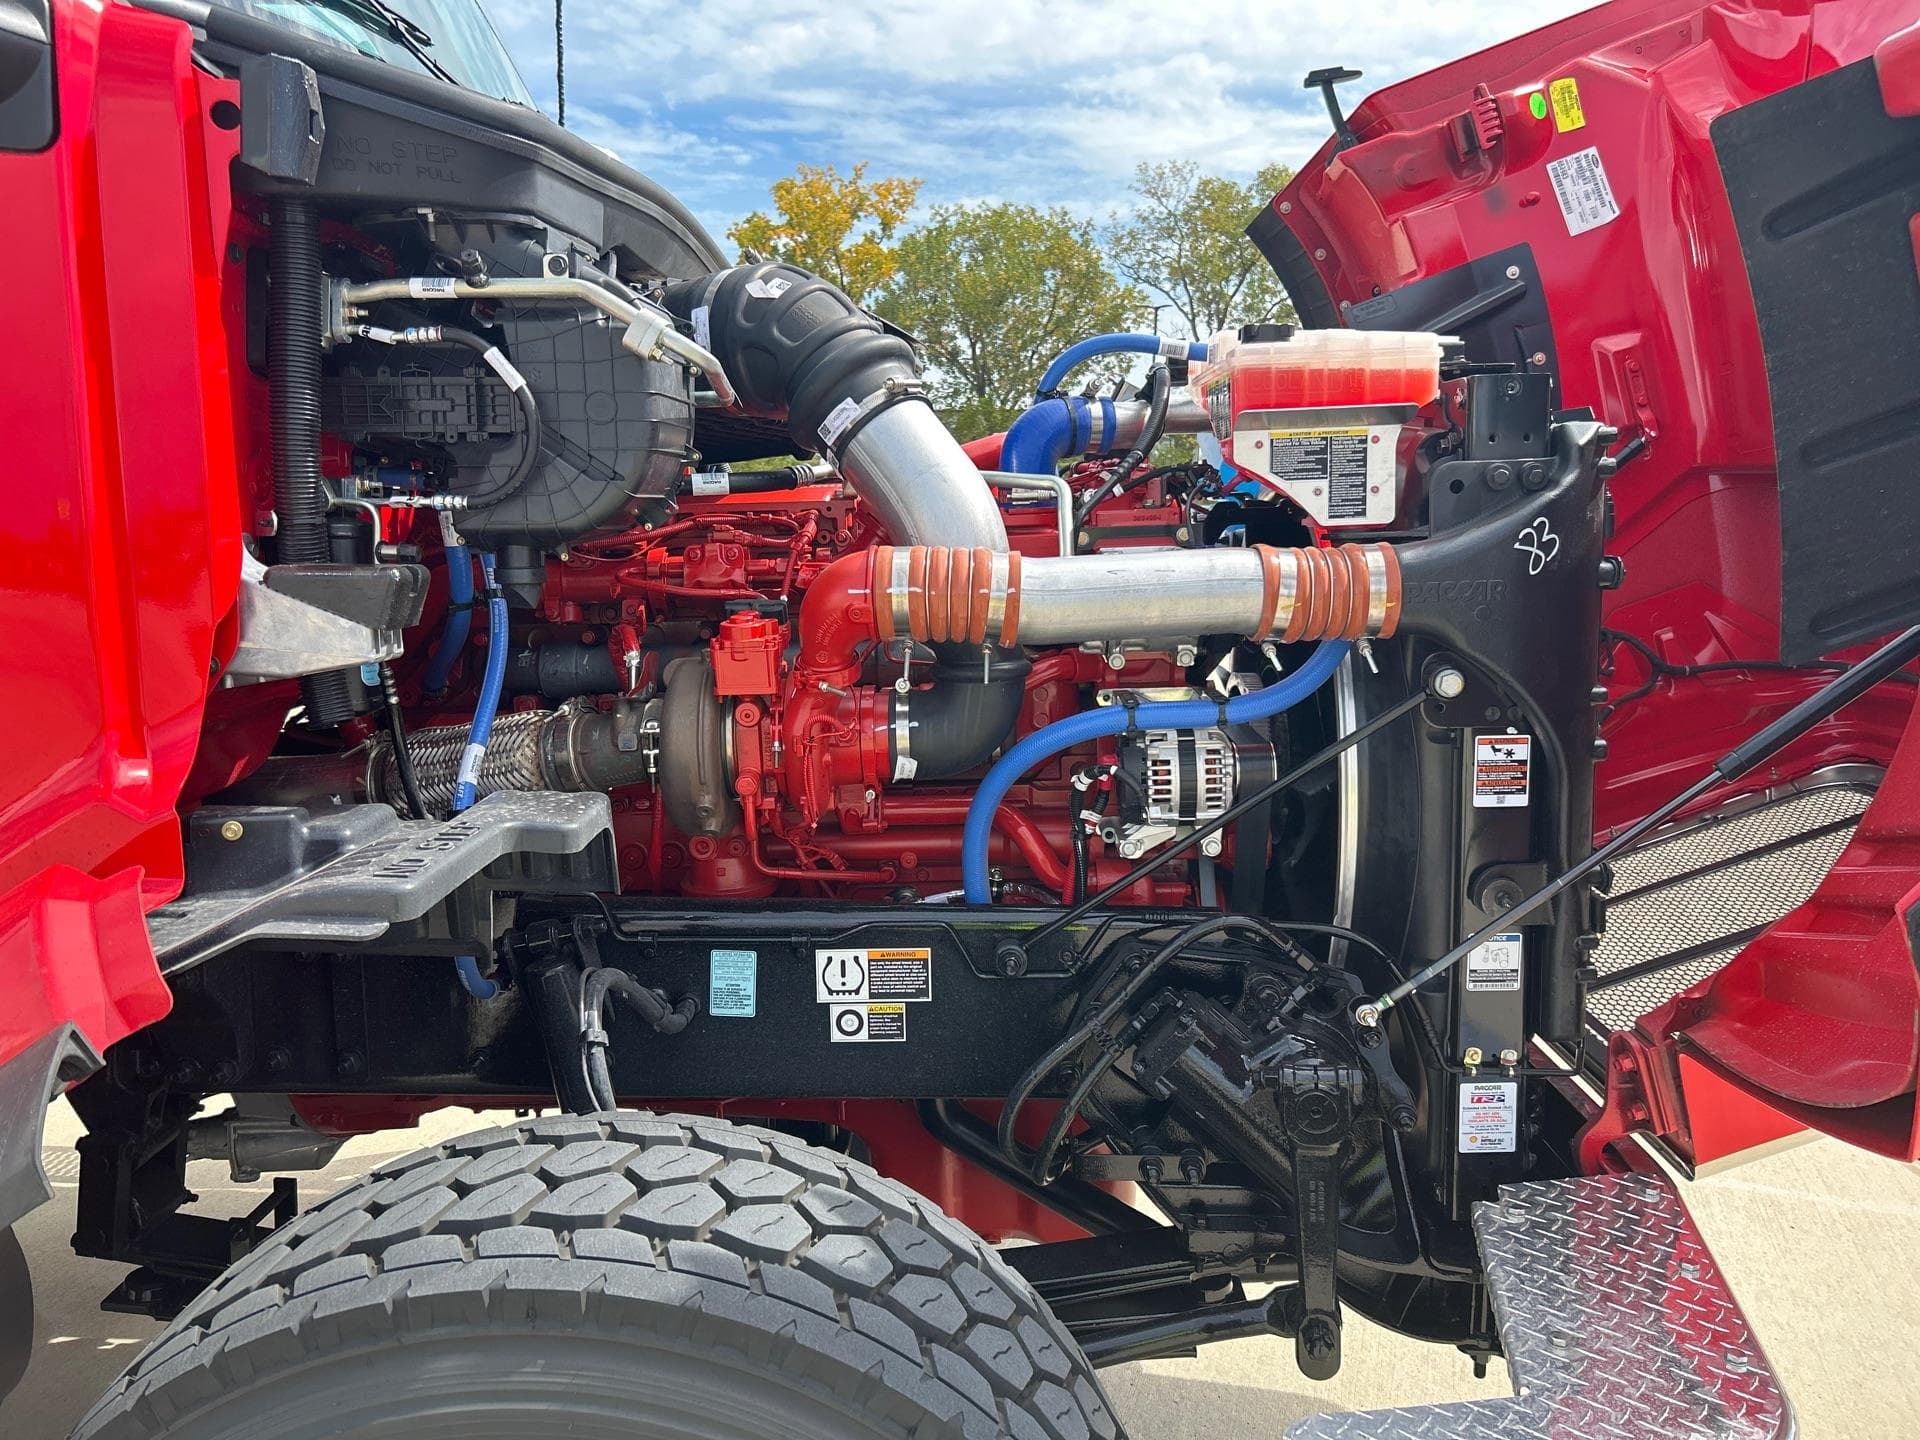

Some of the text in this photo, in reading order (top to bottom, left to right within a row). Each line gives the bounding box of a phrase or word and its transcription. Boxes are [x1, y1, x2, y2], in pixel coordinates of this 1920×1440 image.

[336, 135, 458, 164] NO STEP
[332, 158, 463, 184] DO NOT PULL
[1514, 516, 1560, 576] 83
[1404, 580, 1507, 604] PACCAR
[372, 821, 480, 879] NO STEP
